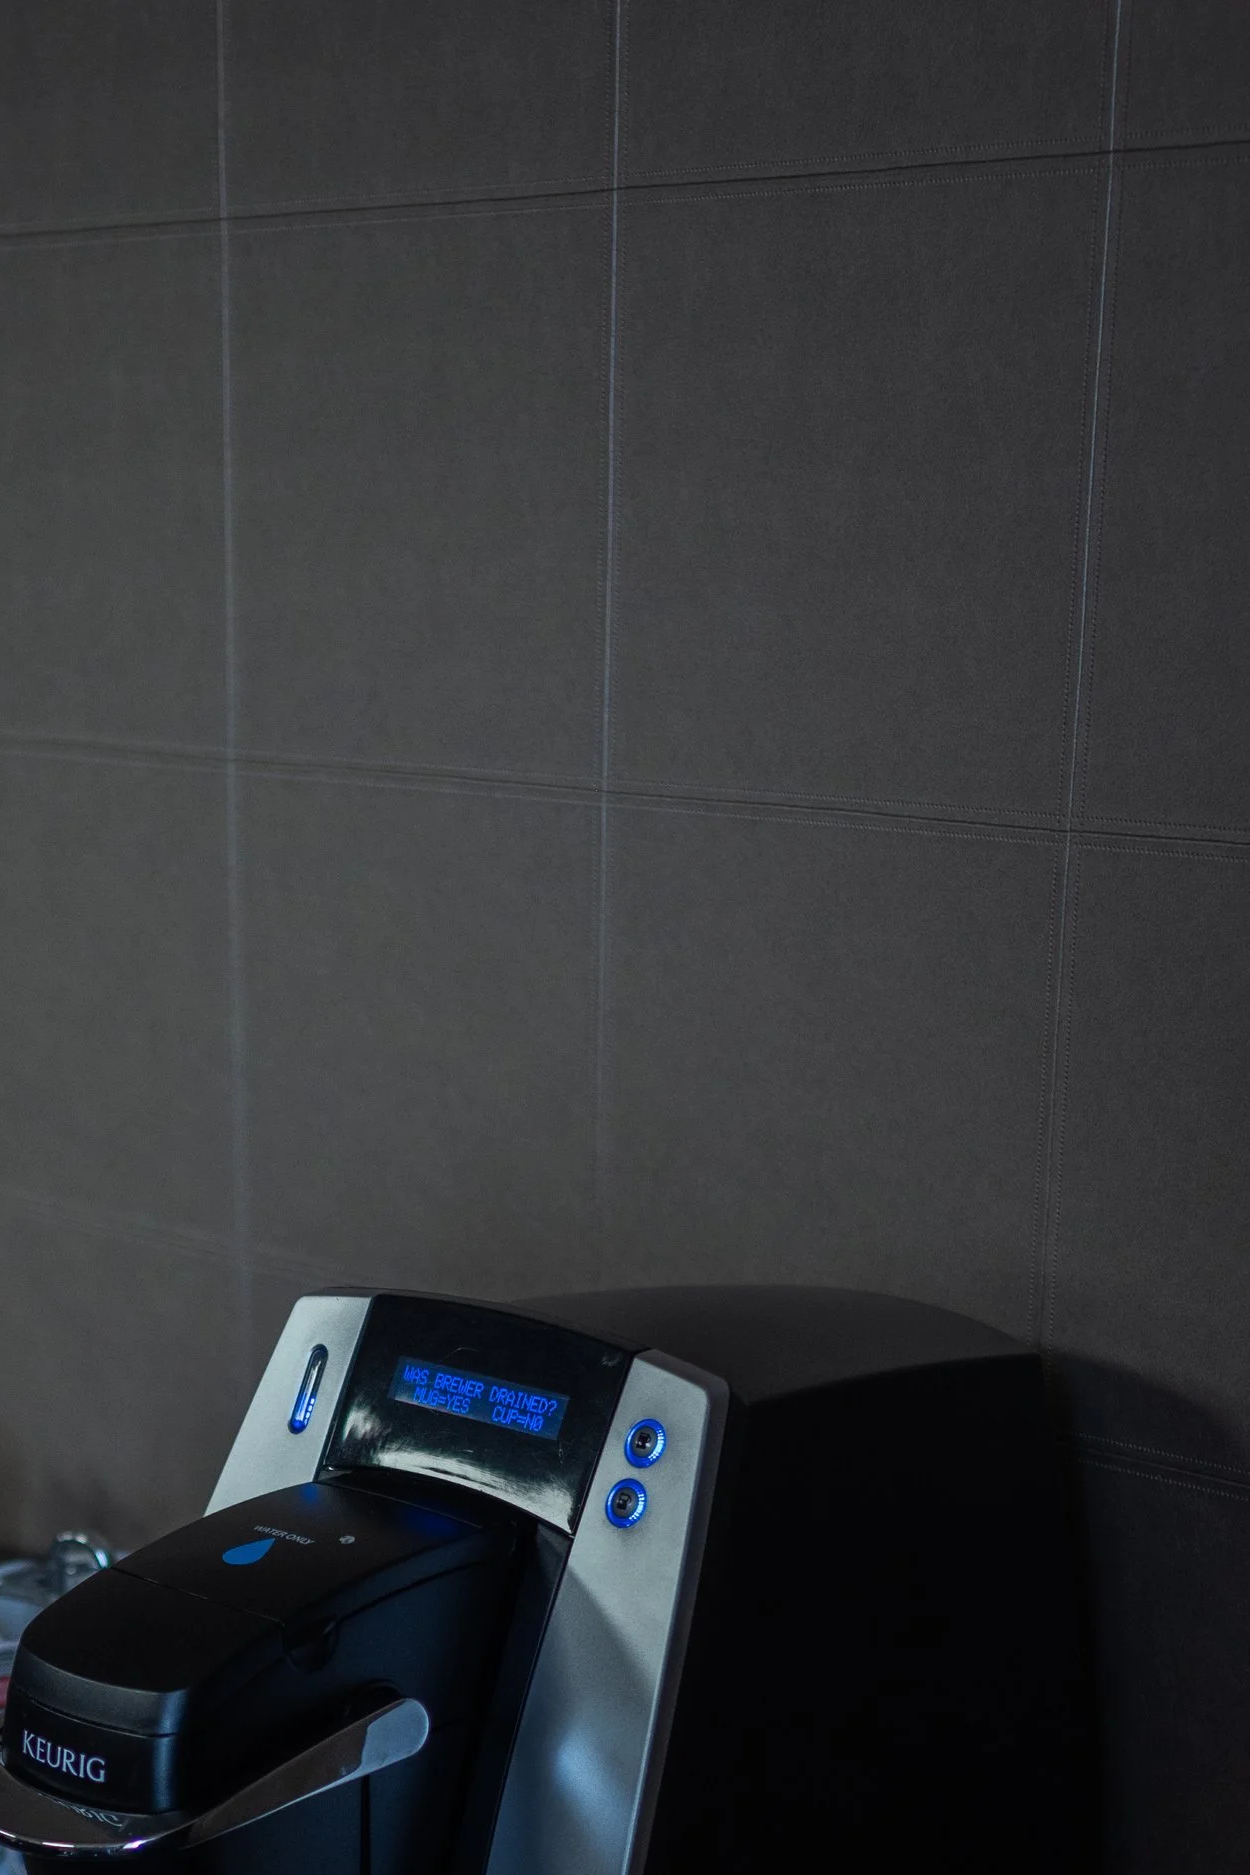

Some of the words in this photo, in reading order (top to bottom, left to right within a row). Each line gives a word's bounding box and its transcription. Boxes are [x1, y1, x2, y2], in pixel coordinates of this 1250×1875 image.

[403, 1364, 430, 1386] WAS
[433, 1372, 485, 1399] BREWER
[488, 1386, 558, 1417] DRAINED?
[413, 1386, 471, 1414] MUG=YES
[253, 1525, 288, 1538] WATER
[285, 1533, 316, 1545] ONLY
[22, 1729, 107, 1783] KEURIG
